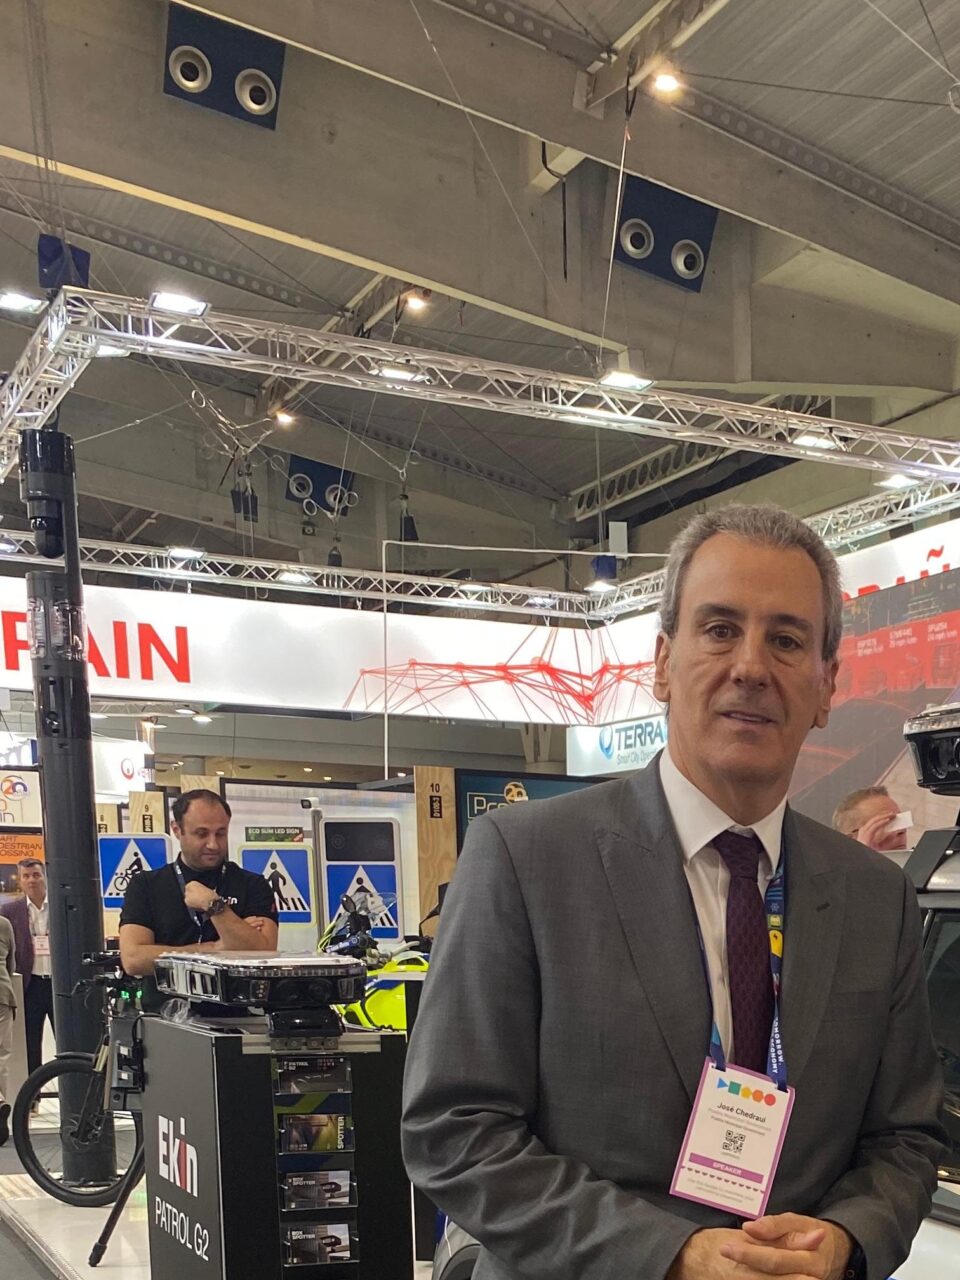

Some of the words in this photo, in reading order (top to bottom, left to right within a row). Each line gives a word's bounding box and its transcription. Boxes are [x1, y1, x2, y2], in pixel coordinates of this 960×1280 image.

[615, 720, 665, 750] TERRA
[430, 783, 441, 793] 10
[337, 1116, 345, 1150] SPOTTER
[158, 1115, 199, 1198] Ekin
[155, 1196, 193, 1250] PATROL
[194, 1222, 209, 1261] G2
